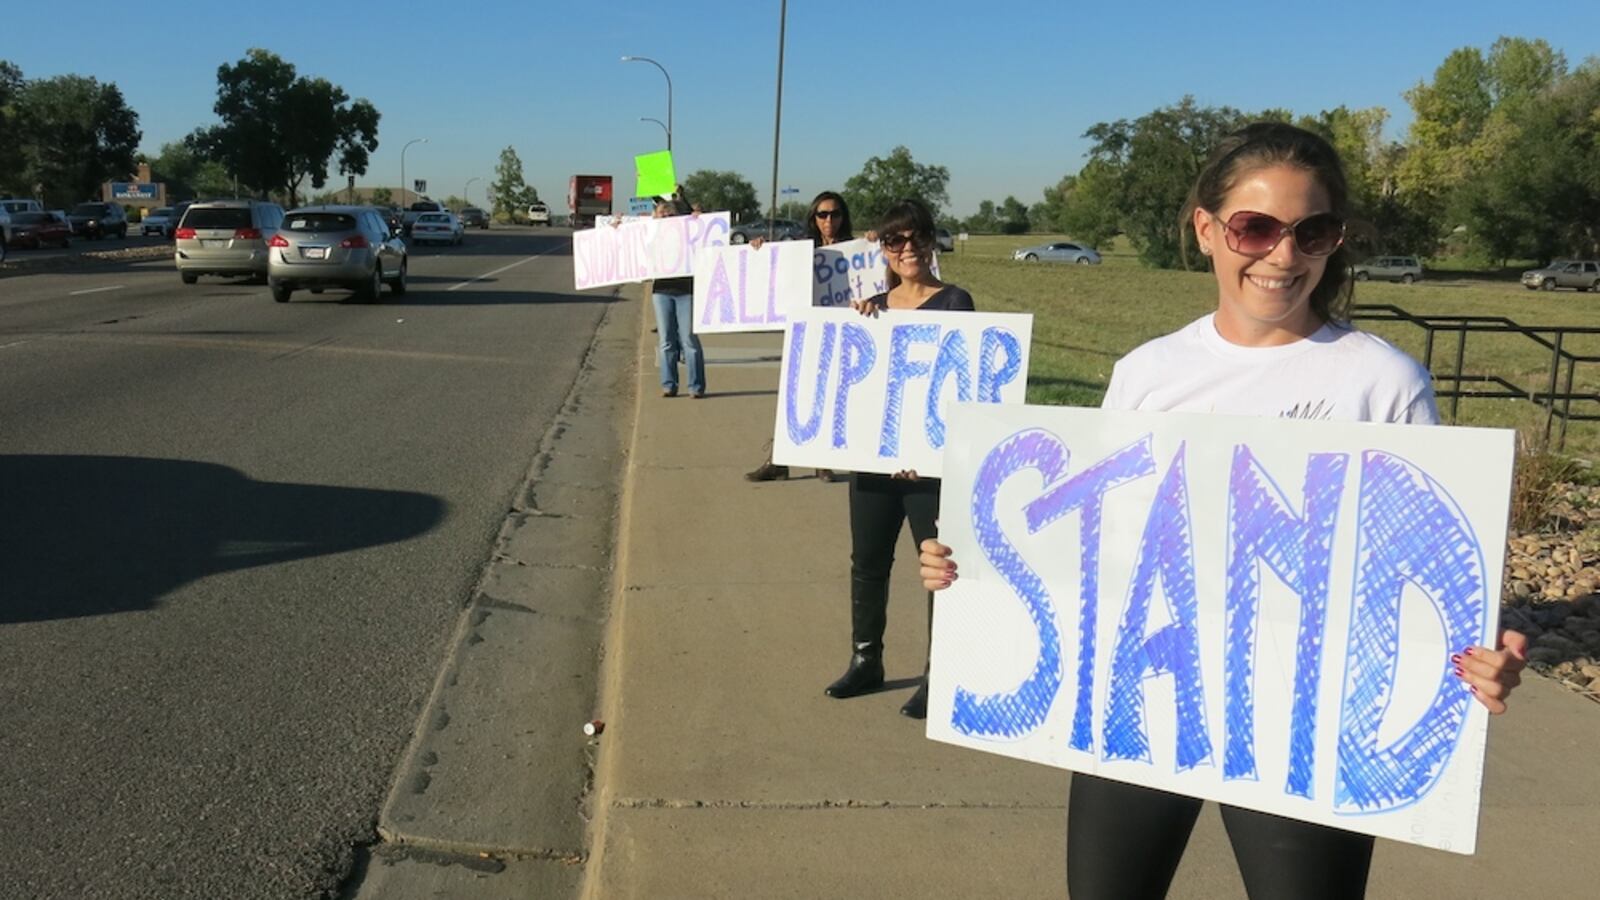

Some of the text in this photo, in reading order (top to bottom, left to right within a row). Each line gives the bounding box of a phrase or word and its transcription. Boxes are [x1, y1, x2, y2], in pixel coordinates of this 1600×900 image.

[702, 245, 787, 325] ALL
[786, 321, 1022, 458] UP FOR
[951, 427, 1487, 816] STAND
